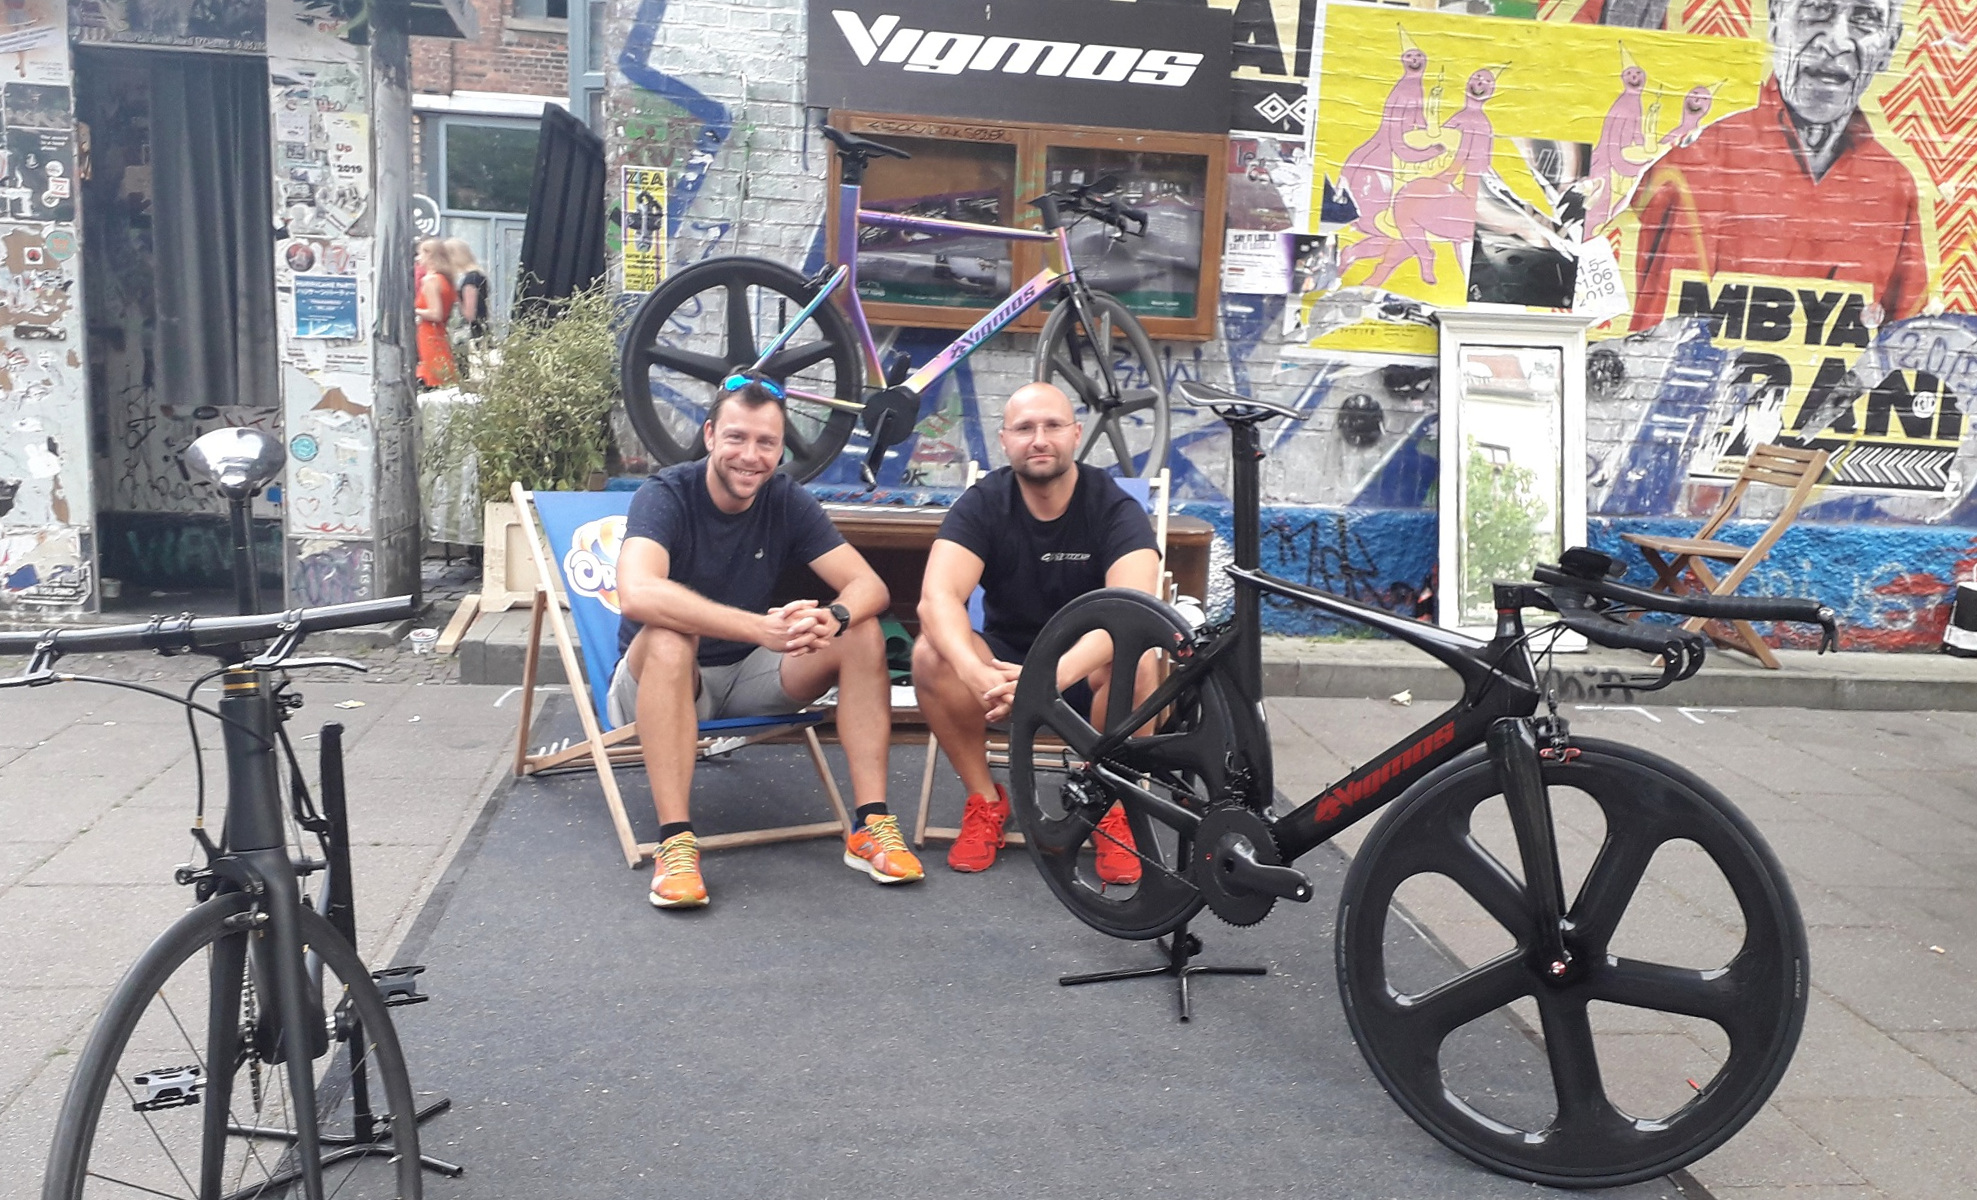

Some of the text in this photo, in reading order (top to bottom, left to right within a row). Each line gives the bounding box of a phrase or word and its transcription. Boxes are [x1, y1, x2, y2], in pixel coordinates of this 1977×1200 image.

[832, 9, 1204, 87] Vigmos
[626, 171, 664, 186] ZEA
[1678, 280, 1869, 349] MBYA
[1332, 720, 1456, 806] Vigmos
